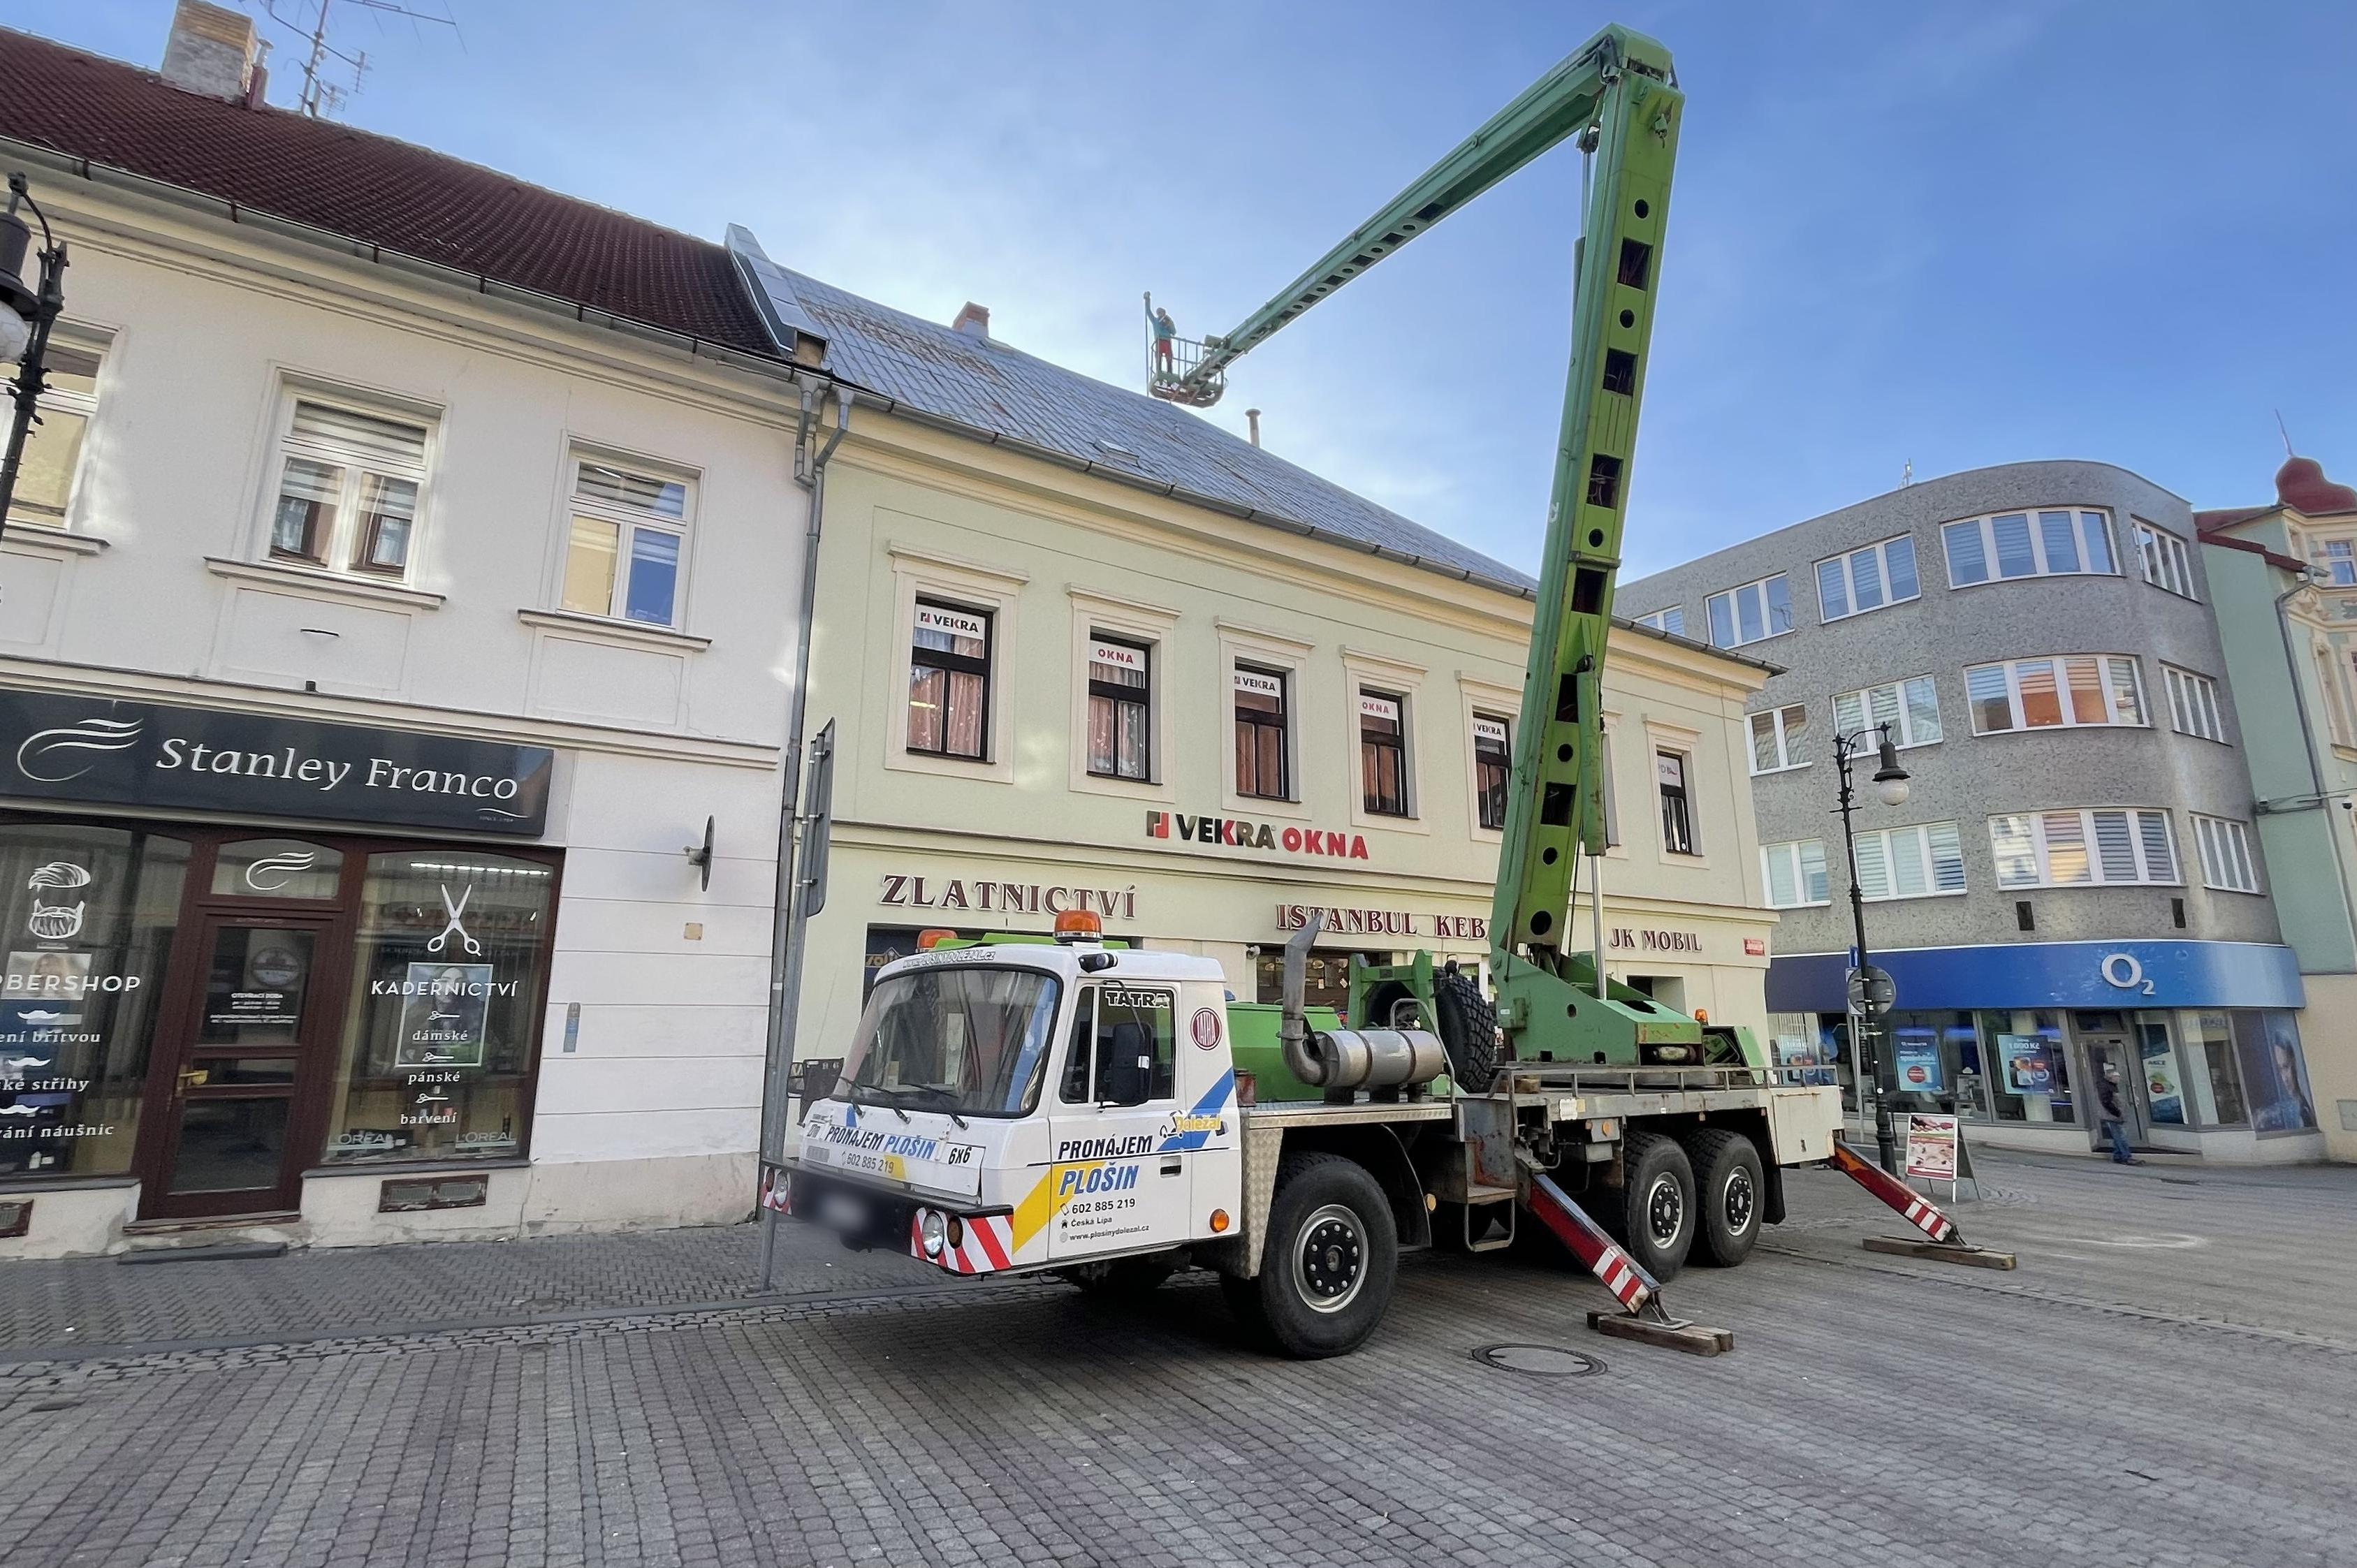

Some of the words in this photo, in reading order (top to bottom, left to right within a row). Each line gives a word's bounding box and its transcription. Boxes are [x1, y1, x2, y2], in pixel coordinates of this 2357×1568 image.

[933, 614, 979, 633] VEKRA
[1097, 648, 1134, 664] OKNA
[1242, 677, 1276, 691] VEKRA
[1362, 701, 1389, 714] OKNA
[1477, 723, 1501, 735] VEKRA
[155, 738, 351, 791] Stanley
[365, 758, 520, 800] Franco
[1175, 813, 1276, 850] VEKRA
[1282, 827, 1369, 860] OKNA
[880, 874, 1136, 919] ZLATNICTVÍ
[1435, 914, 1488, 940] KEB
[1610, 928, 1635, 949] JK
[1642, 929, 1702, 953] MOBIL
[0, 974, 140, 992] BERSHOP
[2101, 953, 2157, 995] O2
[371, 979, 518, 997] KADEŘNICTVÍ
[1105, 990, 1170, 1008] TATRA
[32, 1029, 101, 1043] břitvou
[412, 1030, 468, 1041] dámské
[0, 1078, 25, 1090] ké
[31, 1078, 89, 1092] střihy
[408, 1071, 460, 1085] pánské
[400, 1112, 458, 1124] barvení
[40, 1124, 115, 1138] náušnic
[824, 1125, 885, 1151] PRONÁJEM
[884, 1135, 936, 1159] PLOŠIN
[1058, 1134, 1153, 1159] PRONÁJEM
[847, 1152, 861, 1166] 602
[861, 1156, 876, 1169] 885
[877, 1159, 894, 1173] 219
[1059, 1162, 1139, 1196] PLOŠIN
[1072, 1203, 1091, 1214] 602
[1095, 1201, 1114, 1211] 885
[1117, 1198, 1135, 1209] 219
